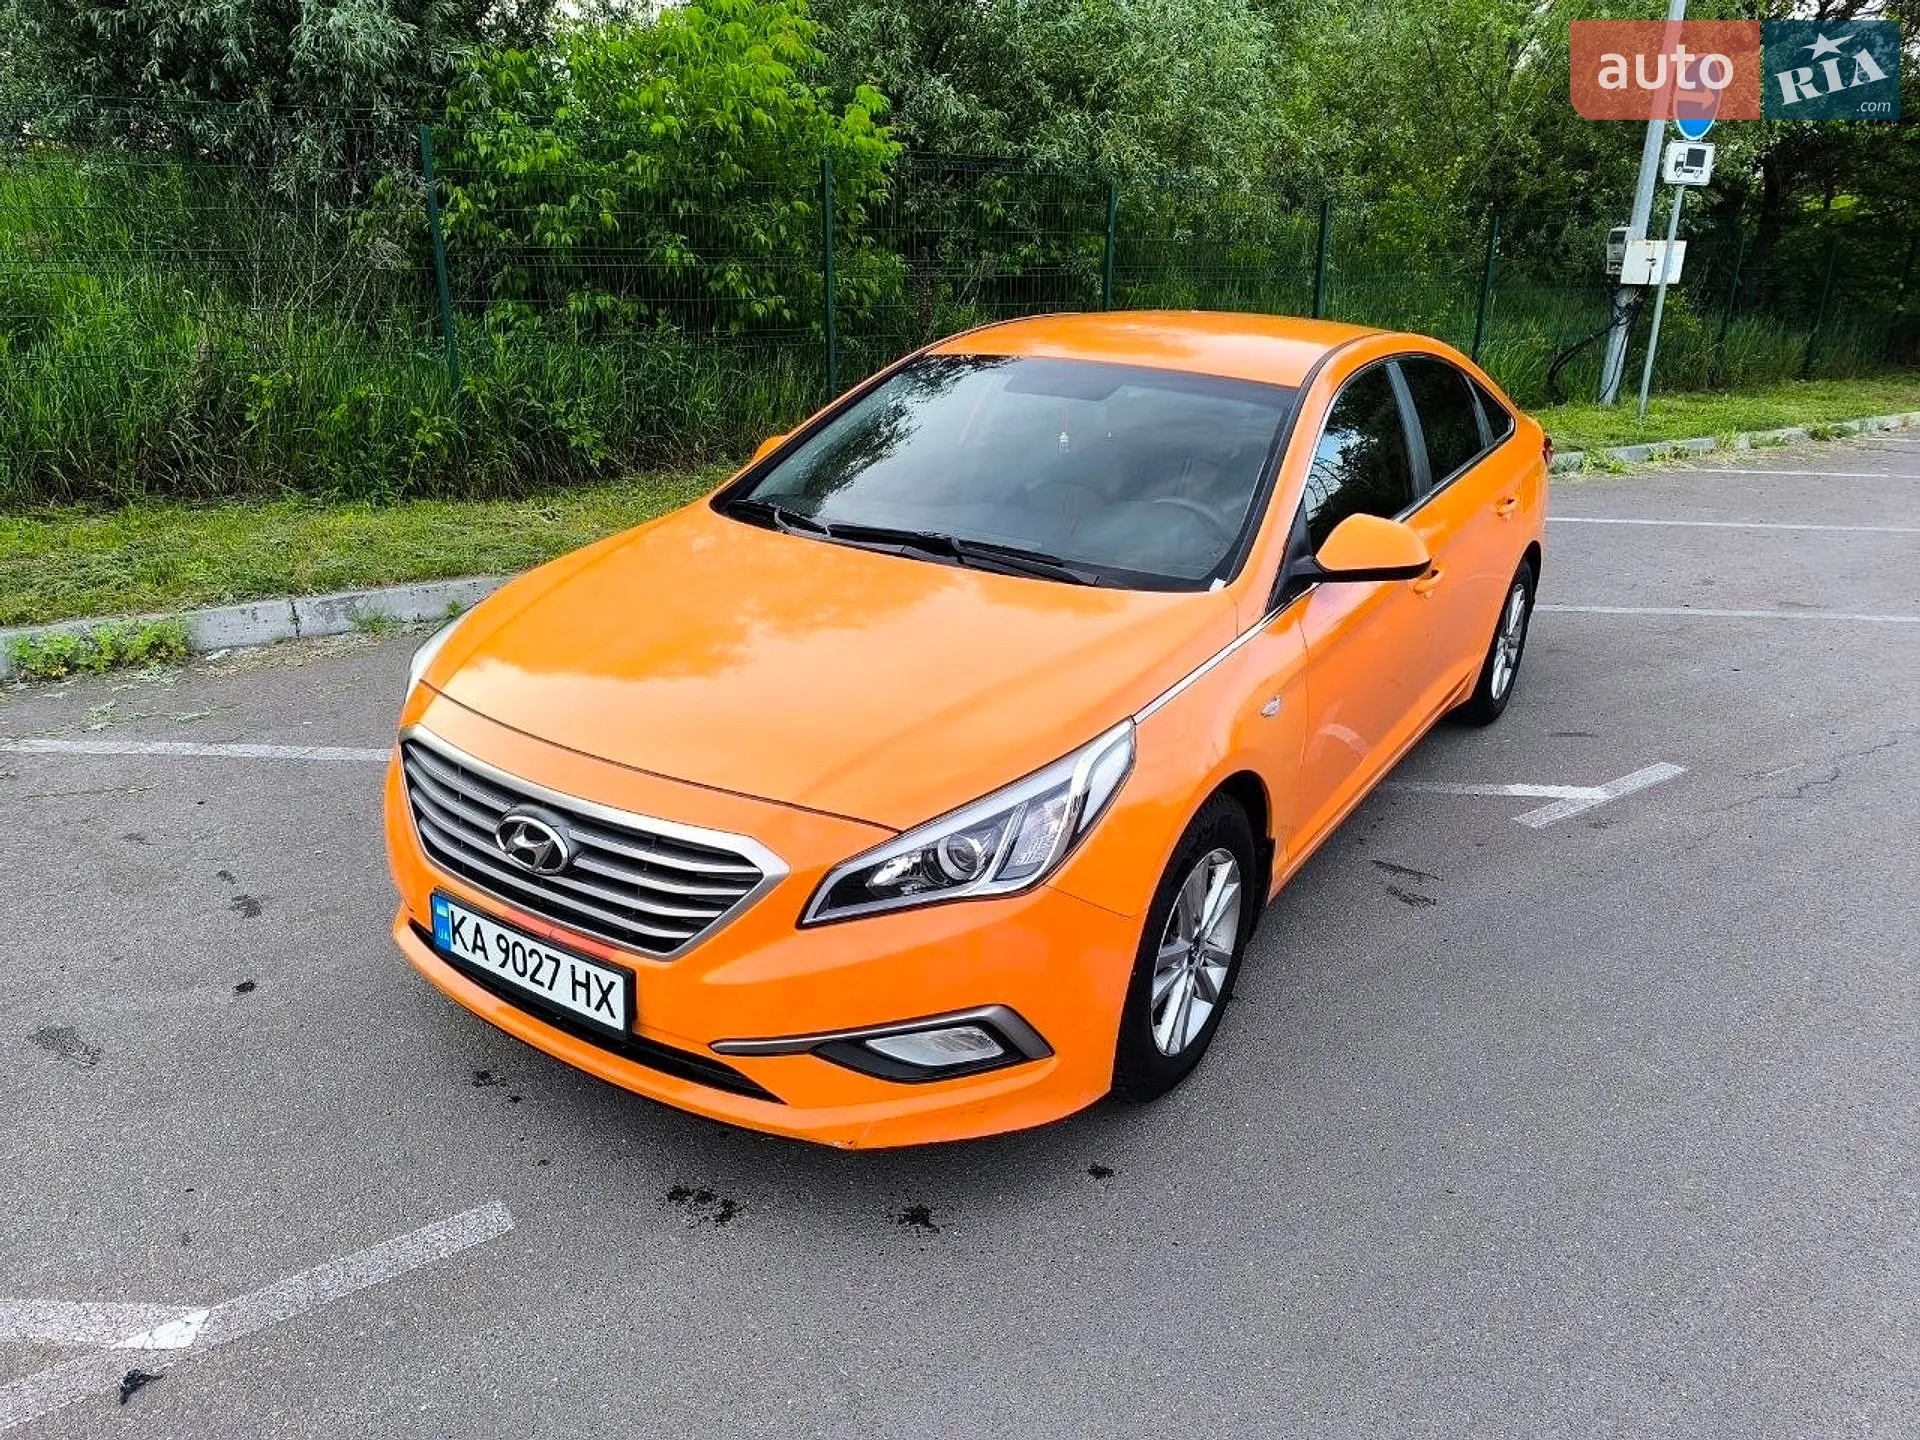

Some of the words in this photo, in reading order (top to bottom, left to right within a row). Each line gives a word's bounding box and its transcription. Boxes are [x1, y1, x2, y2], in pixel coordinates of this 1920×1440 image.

[450, 910, 489, 961] KA
[496, 934, 561, 991] 9027
[571, 964, 617, 1019] HX
